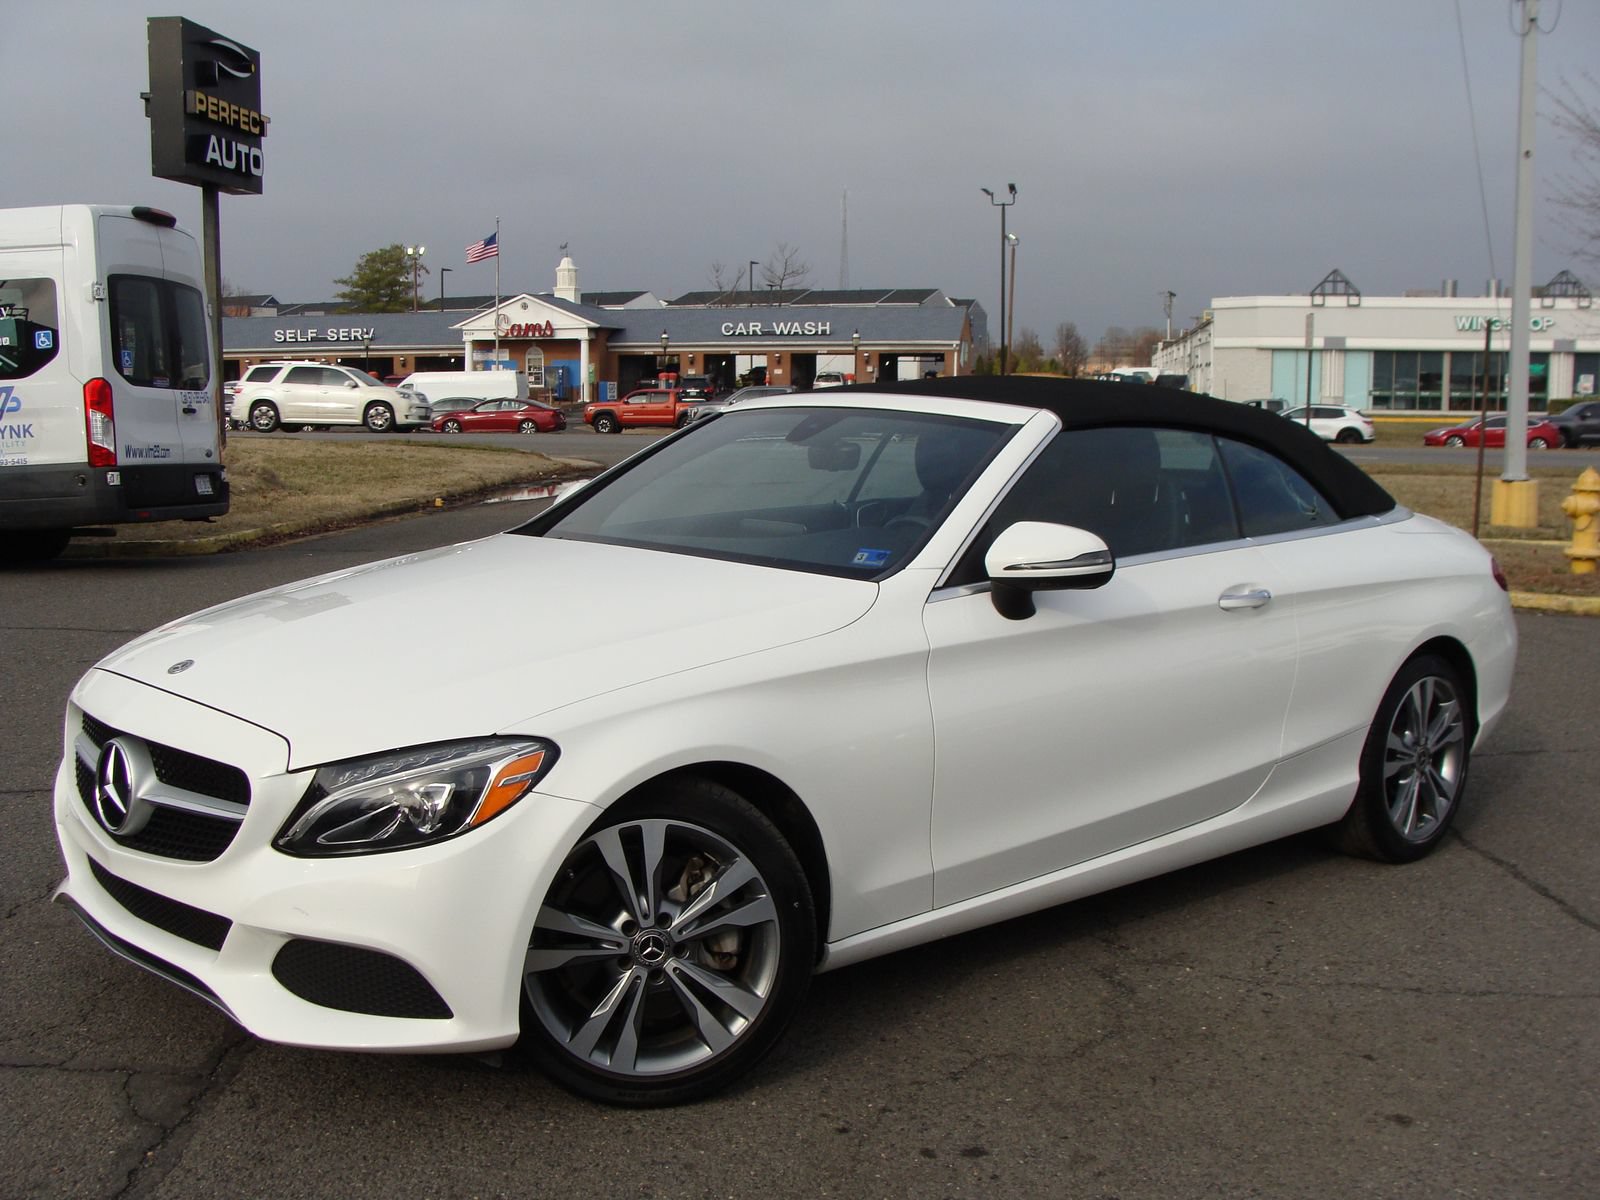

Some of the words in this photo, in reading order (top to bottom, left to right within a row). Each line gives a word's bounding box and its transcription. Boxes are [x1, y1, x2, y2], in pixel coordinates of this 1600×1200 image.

[195, 90, 271, 137] PERFECT
[205, 134, 264, 177] AUTO
[274, 329, 317, 342] SELF
[721, 322, 762, 336] CAR
[772, 321, 830, 335] WASH
